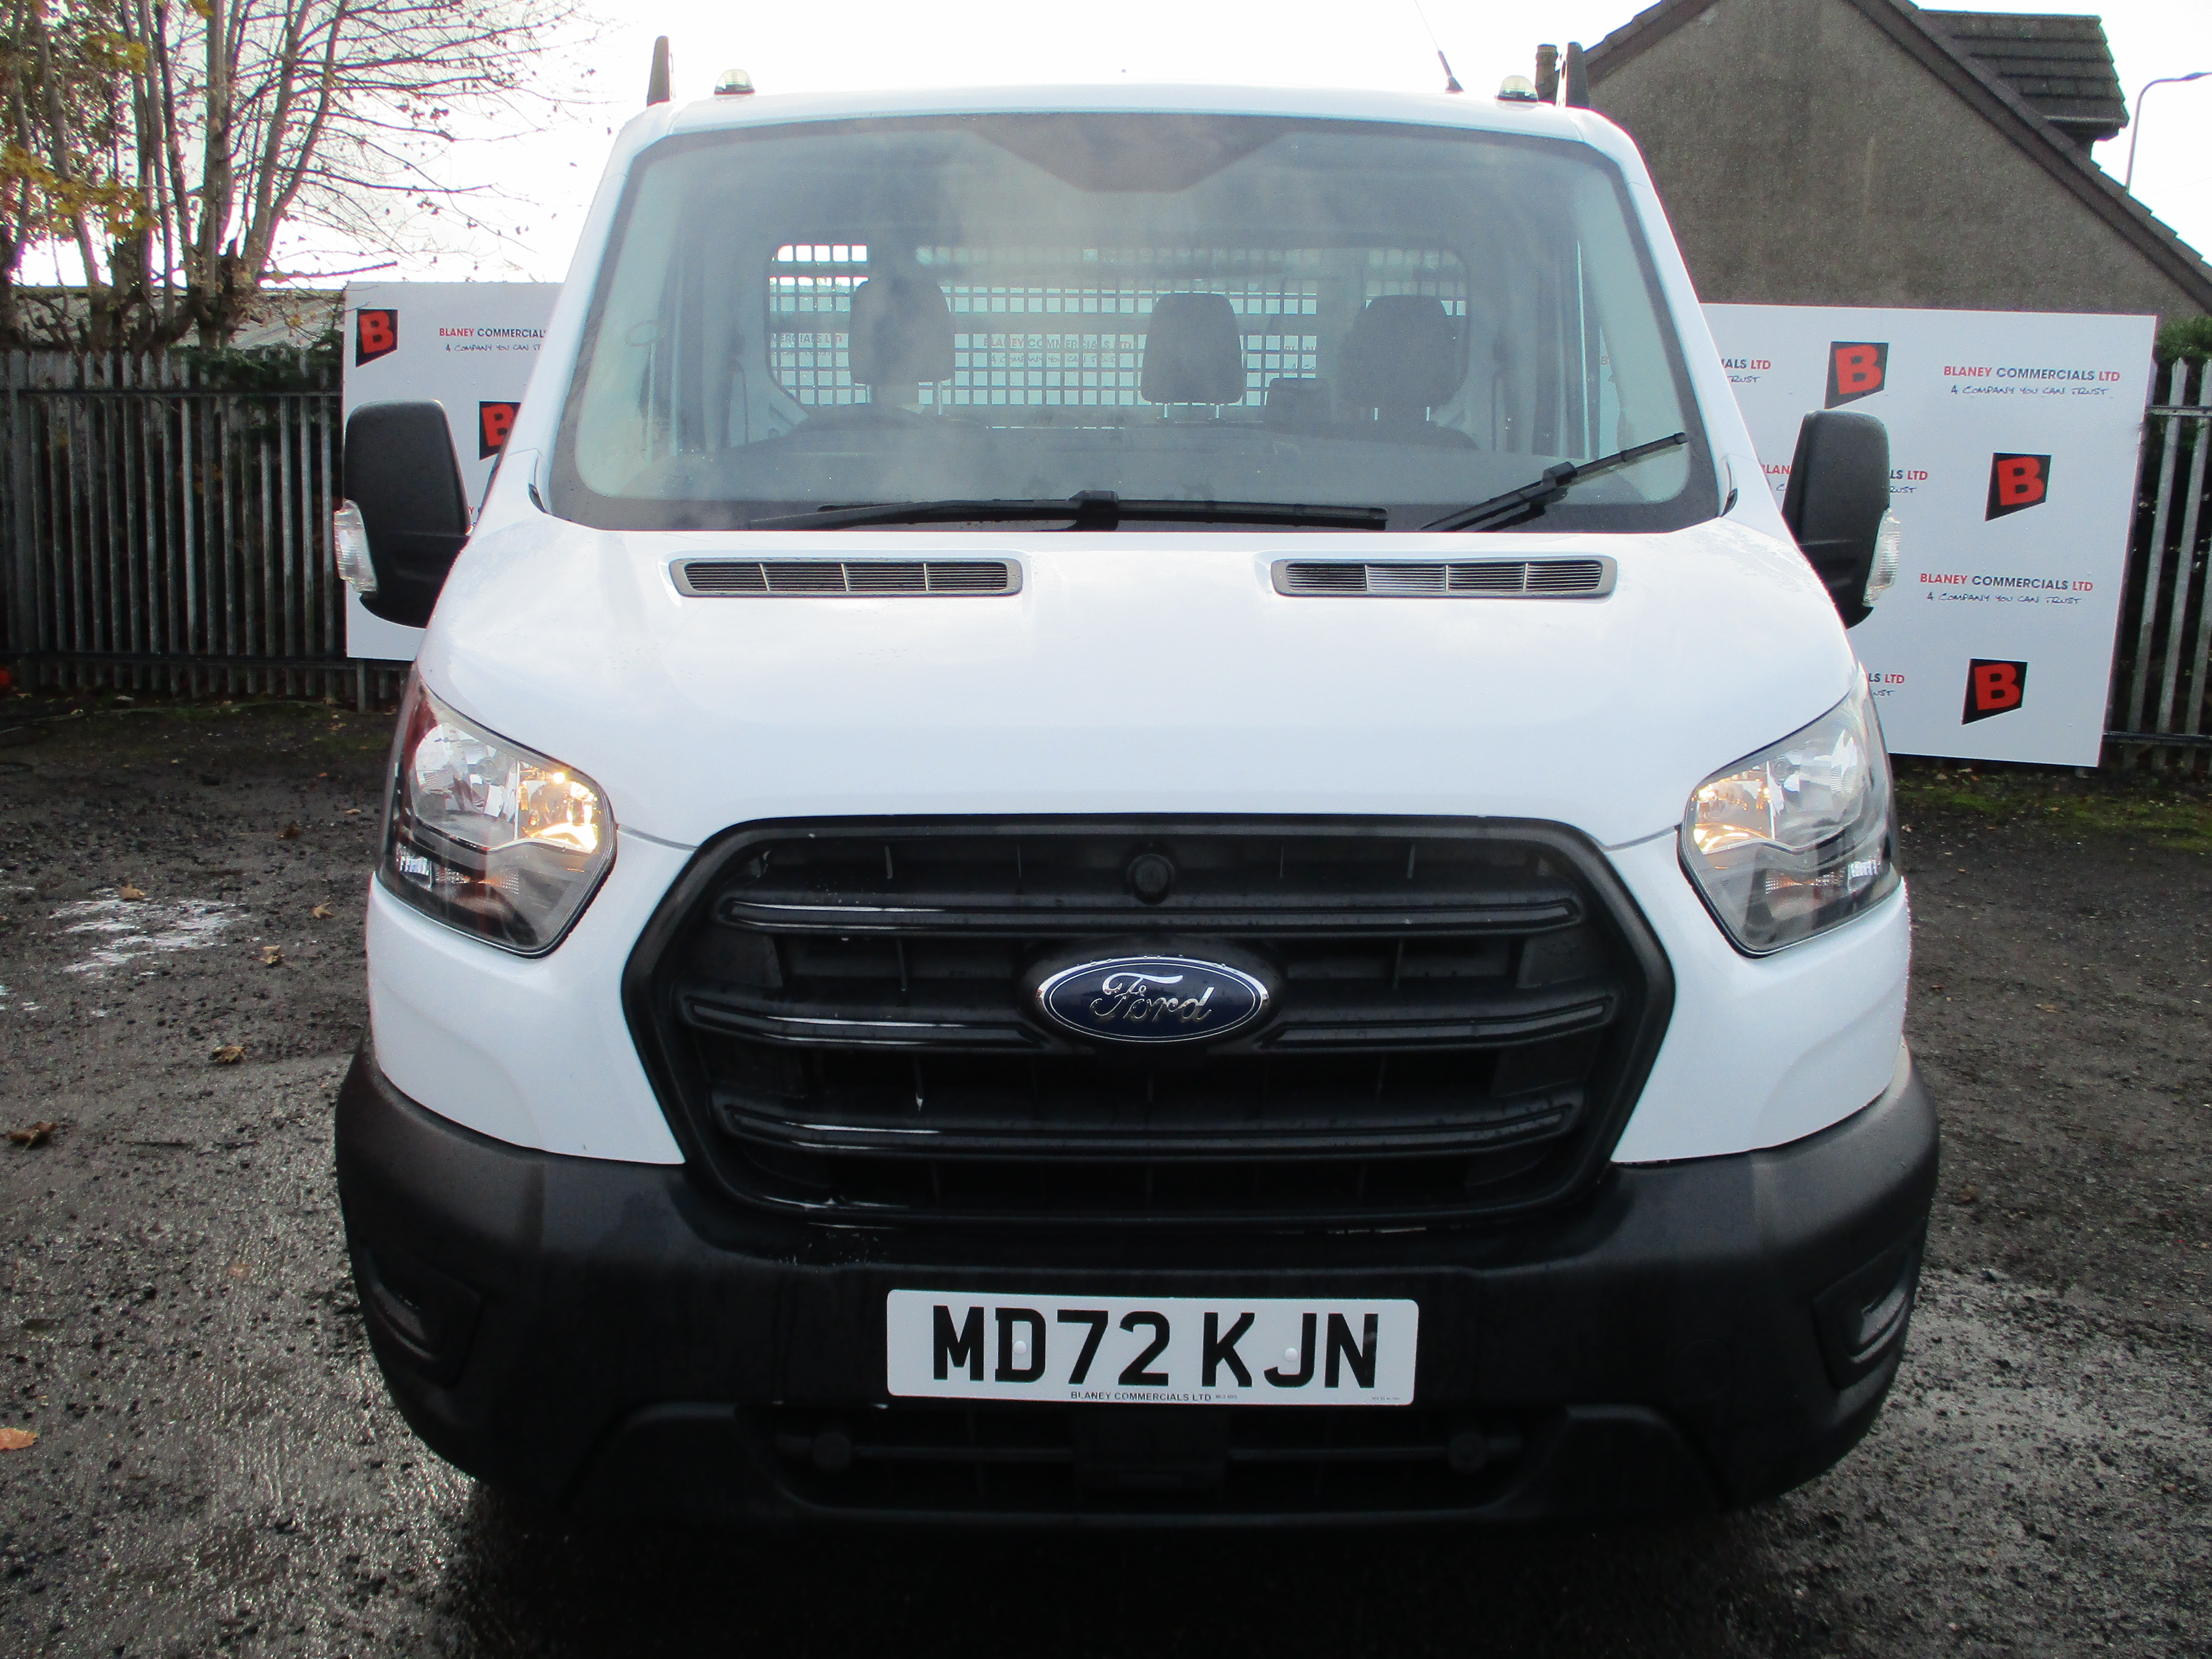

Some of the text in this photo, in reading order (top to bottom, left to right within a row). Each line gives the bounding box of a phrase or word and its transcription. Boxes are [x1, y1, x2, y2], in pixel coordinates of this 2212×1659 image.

[359, 310, 394, 354] B
[439, 328, 546, 338] BLANEY COMMERCIAL
[1750, 359, 1771, 370] LTD
[1835, 344, 1882, 395] B
[1944, 366, 2121, 382] BLANEY COMMERCIALS LTD
[1951, 385, 1958, 394] A
[1963, 386, 2015, 395] COMPANY
[2071, 387, 2110, 395] TRUST
[1908, 470, 1928, 480] LTD
[1997, 456, 2044, 507] B
[1920, 573, 2094, 592] BLANEY COMMERCIALS LTD
[1926, 592, 2082, 604] A COMPANY YOU CAN TRUST
[1884, 674, 1905, 684] LTD
[1975, 663, 2021, 711] B
[1090, 972, 1215, 1021] Ford
[933, 1305, 1379, 1389] MD72 KJN
[1071, 1391, 1110, 1400] BLANEY
[1115, 1392, 1189, 1401] COMMERCIALS
[1192, 1393, 1211, 1401] LTD
